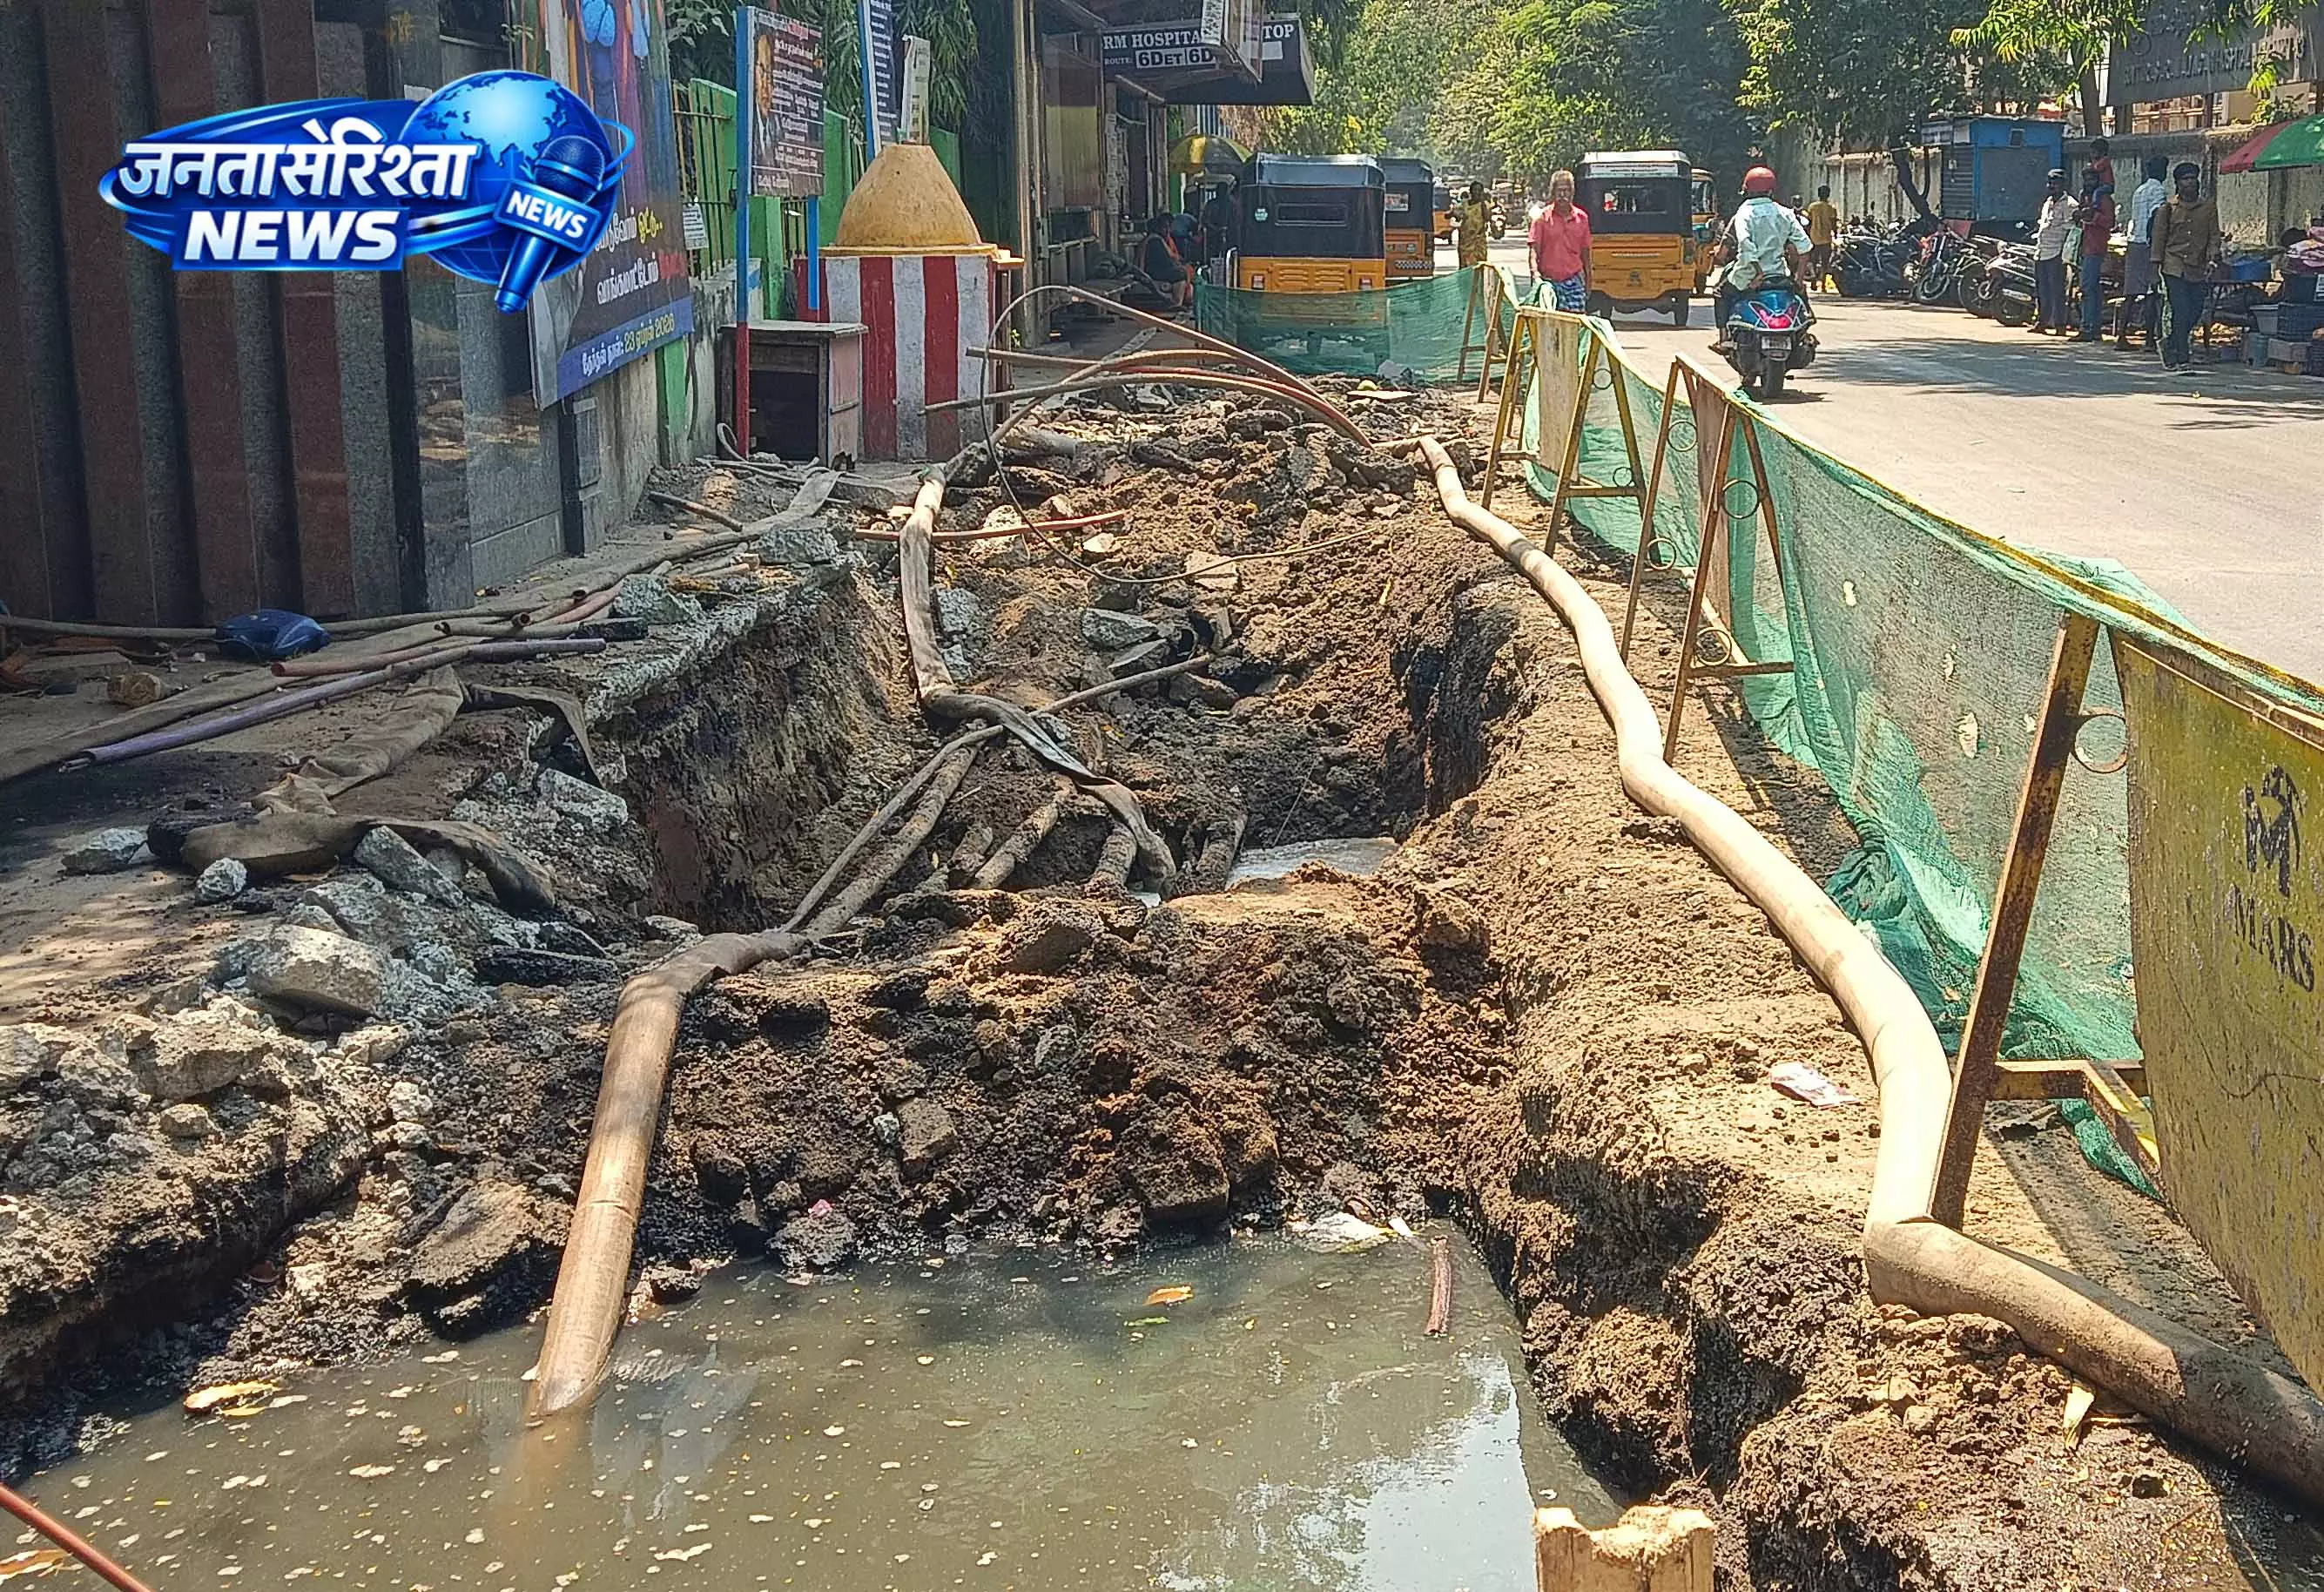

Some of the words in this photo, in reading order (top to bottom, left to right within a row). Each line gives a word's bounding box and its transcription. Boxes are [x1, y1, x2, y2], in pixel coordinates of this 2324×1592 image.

[1103, 35, 1128, 49] RM
[1131, 30, 1205, 48] HOSPITA
[1263, 24, 1294, 39] TOP
[624, 334, 635, 353] 23
[655, 313, 675, 338] 2026
